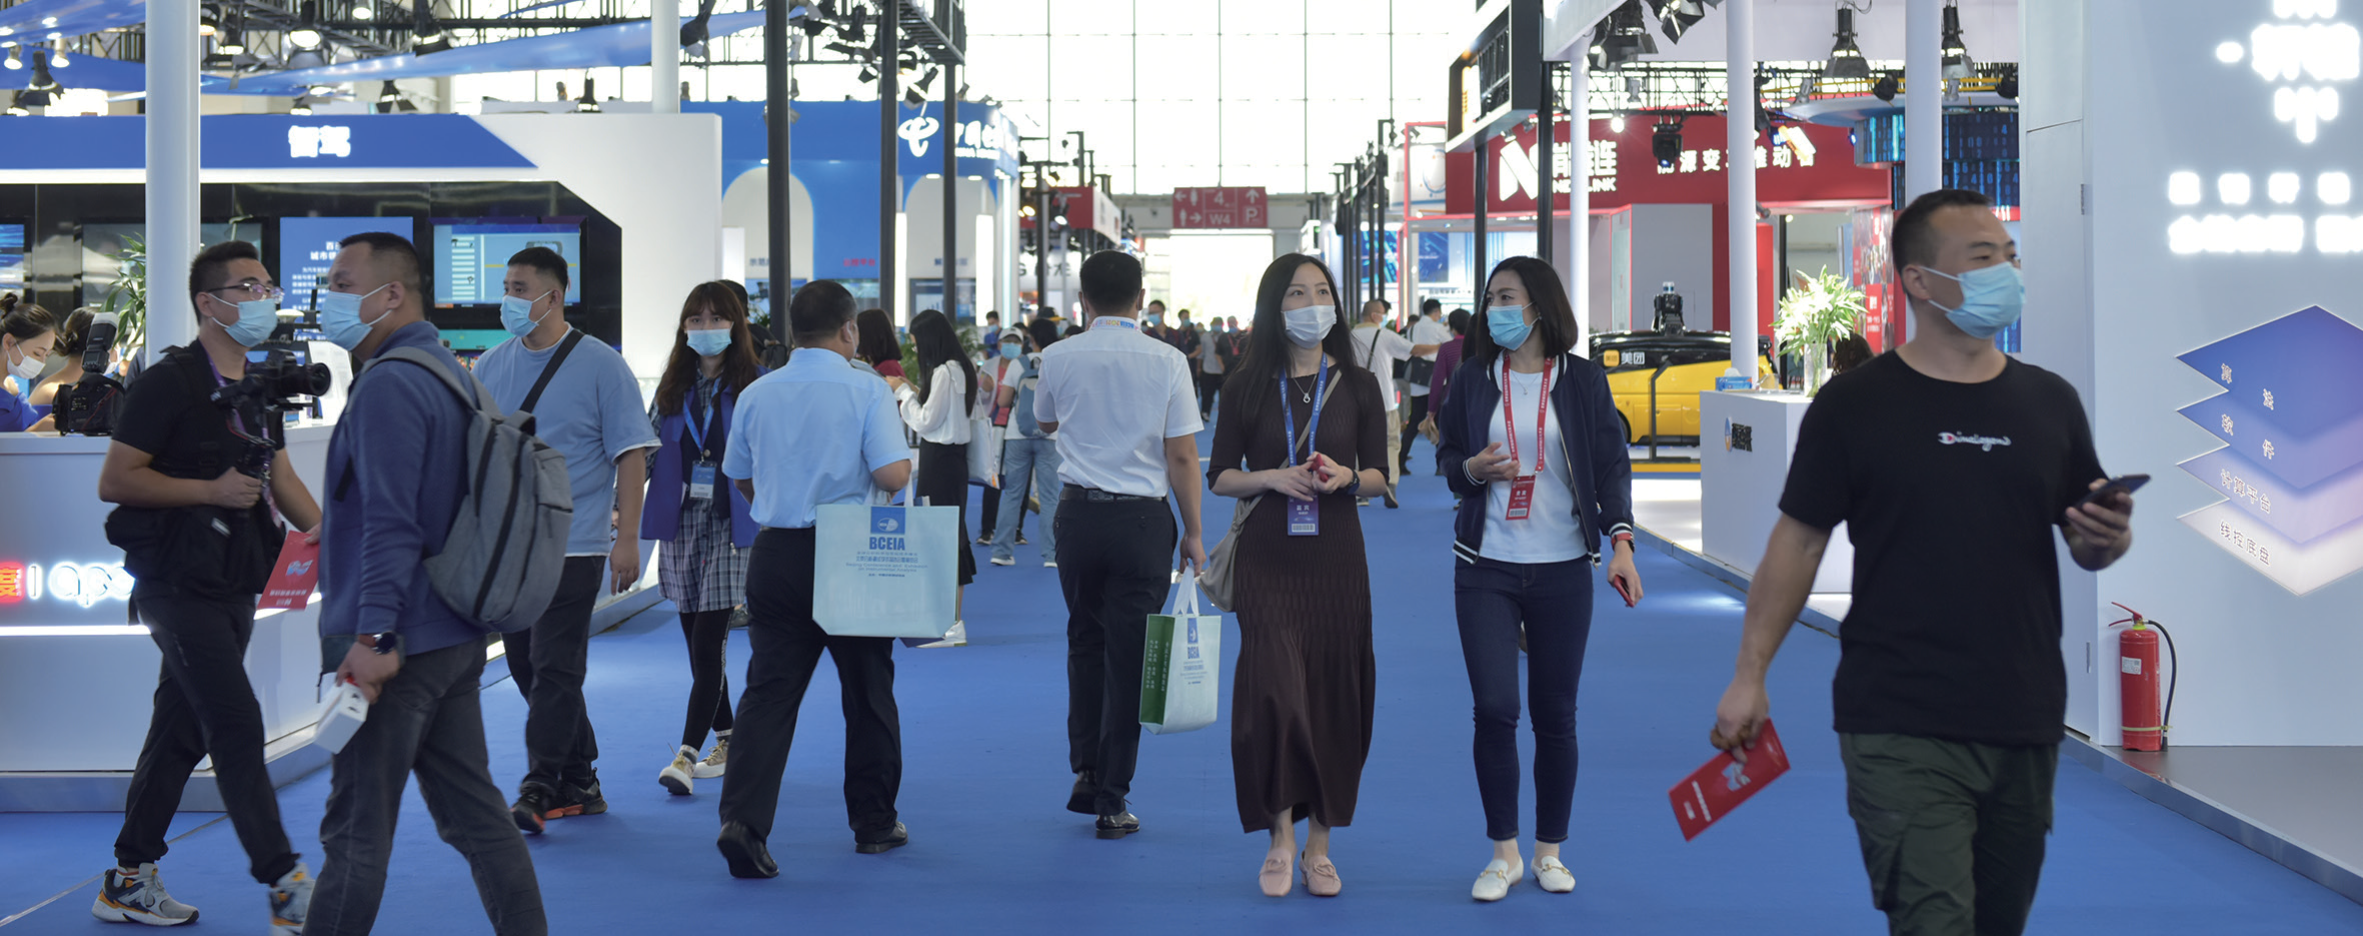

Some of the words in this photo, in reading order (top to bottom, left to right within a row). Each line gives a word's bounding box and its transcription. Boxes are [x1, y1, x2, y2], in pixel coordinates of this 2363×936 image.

[1213, 190, 1224, 206] 4
[1209, 213, 1231, 225] W4
[1621, 352, 1645, 365] 美团
[2221, 413, 2275, 460] 软件
[2220, 468, 2272, 514] 计算平台
[869, 536, 906, 551] BCEIA
[2219, 520, 2271, 566] 线控底盘
